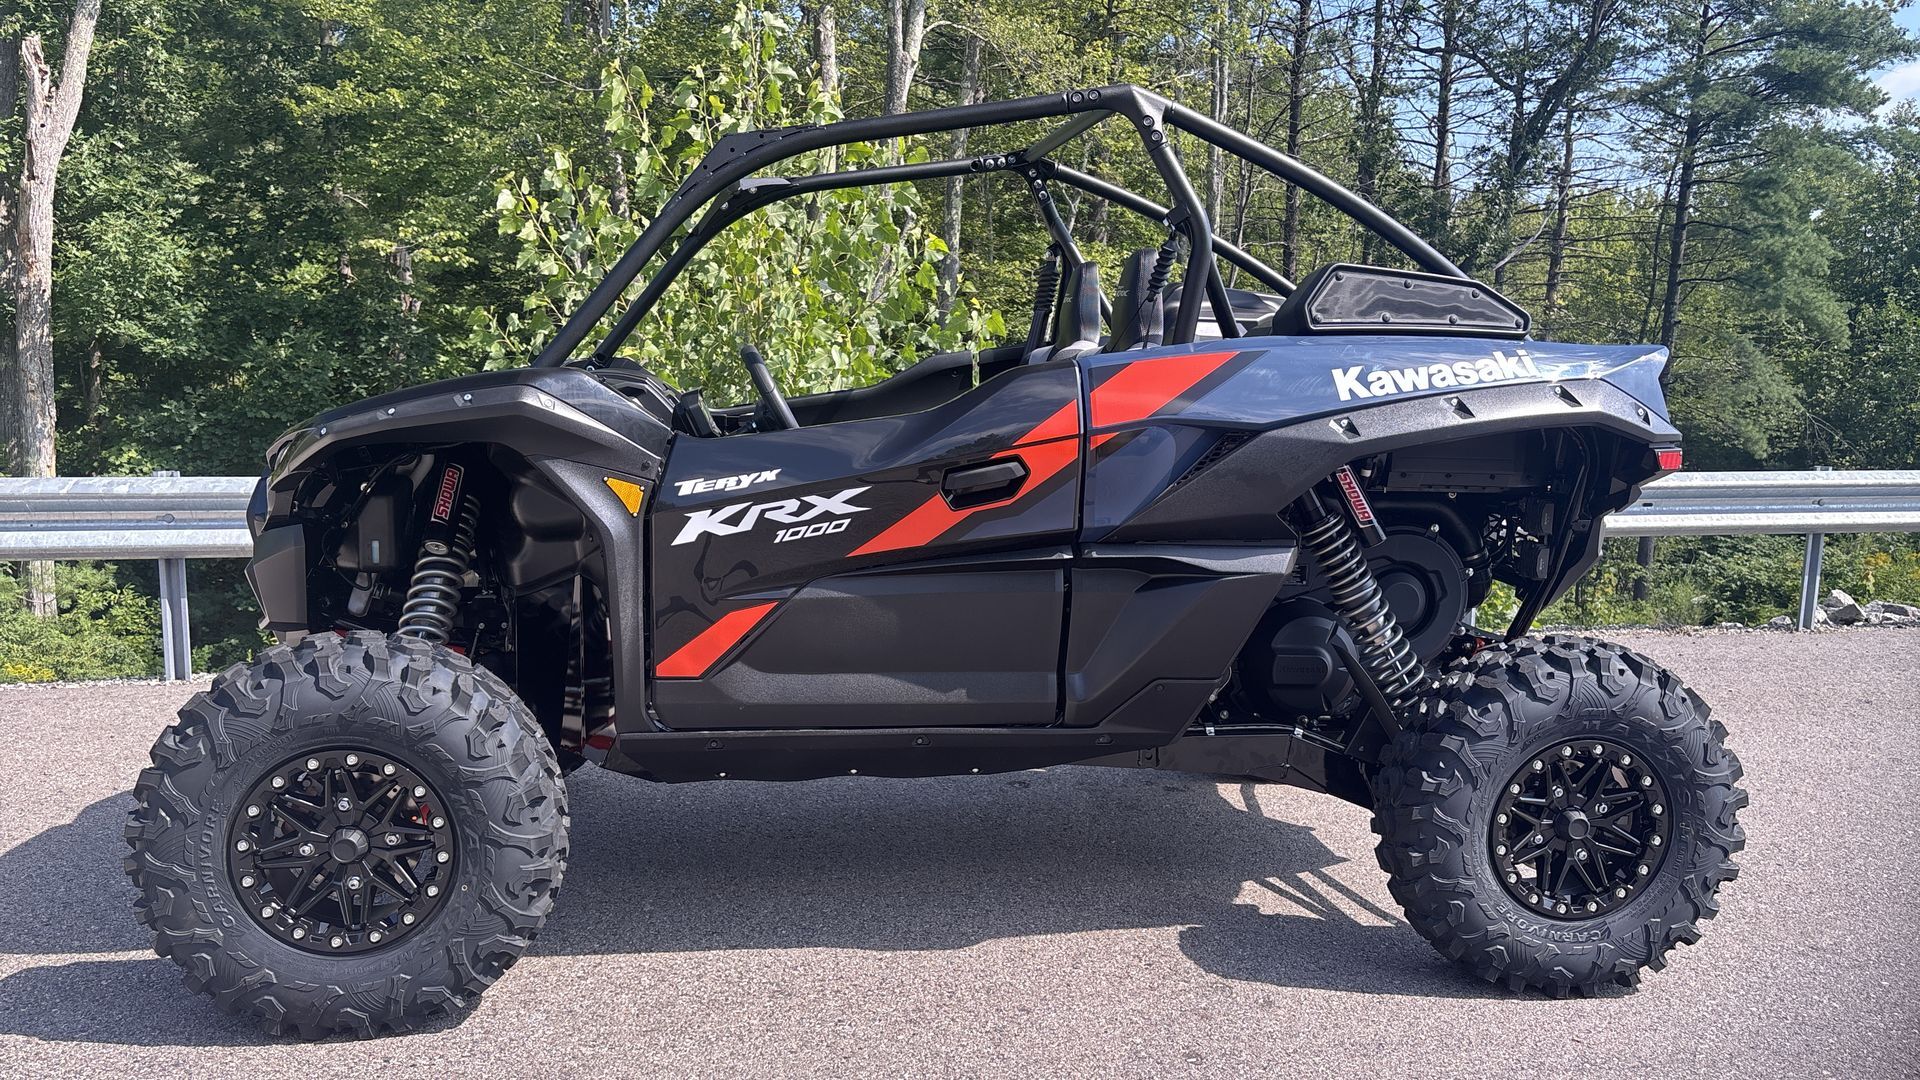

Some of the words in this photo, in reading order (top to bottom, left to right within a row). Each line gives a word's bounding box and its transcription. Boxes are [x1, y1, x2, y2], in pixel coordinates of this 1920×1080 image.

[1331, 349, 1541, 401] Kawasaki
[435, 467, 460, 520] SHOWA
[670, 486, 872, 546] KRX
[1336, 471, 1373, 521] SHOWA
[773, 518, 852, 544] 1000
[199, 799, 236, 928] CARNIVORE
[1496, 902, 1601, 943] CARNIVORE
